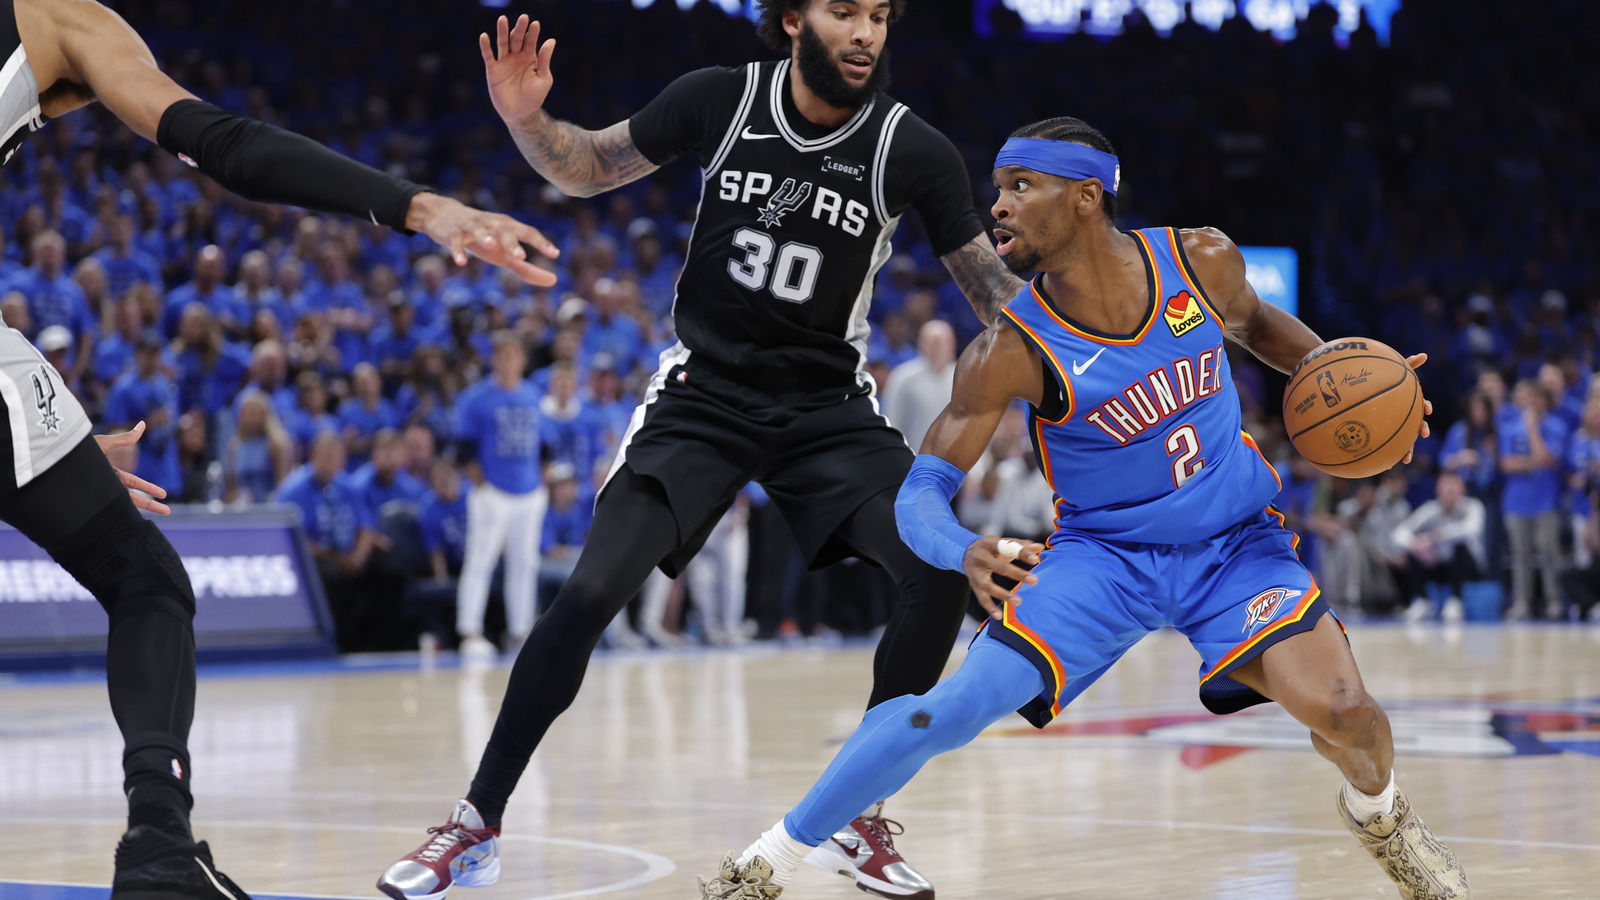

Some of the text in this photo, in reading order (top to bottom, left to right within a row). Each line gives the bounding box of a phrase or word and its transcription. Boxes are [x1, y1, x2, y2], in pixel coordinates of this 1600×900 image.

[827, 161, 860, 177] LEDGER
[719, 170, 869, 238] SPURS
[727, 226, 824, 304] 30
[1084, 344, 1223, 447] THUNDER
[1165, 424, 1206, 490] 2
